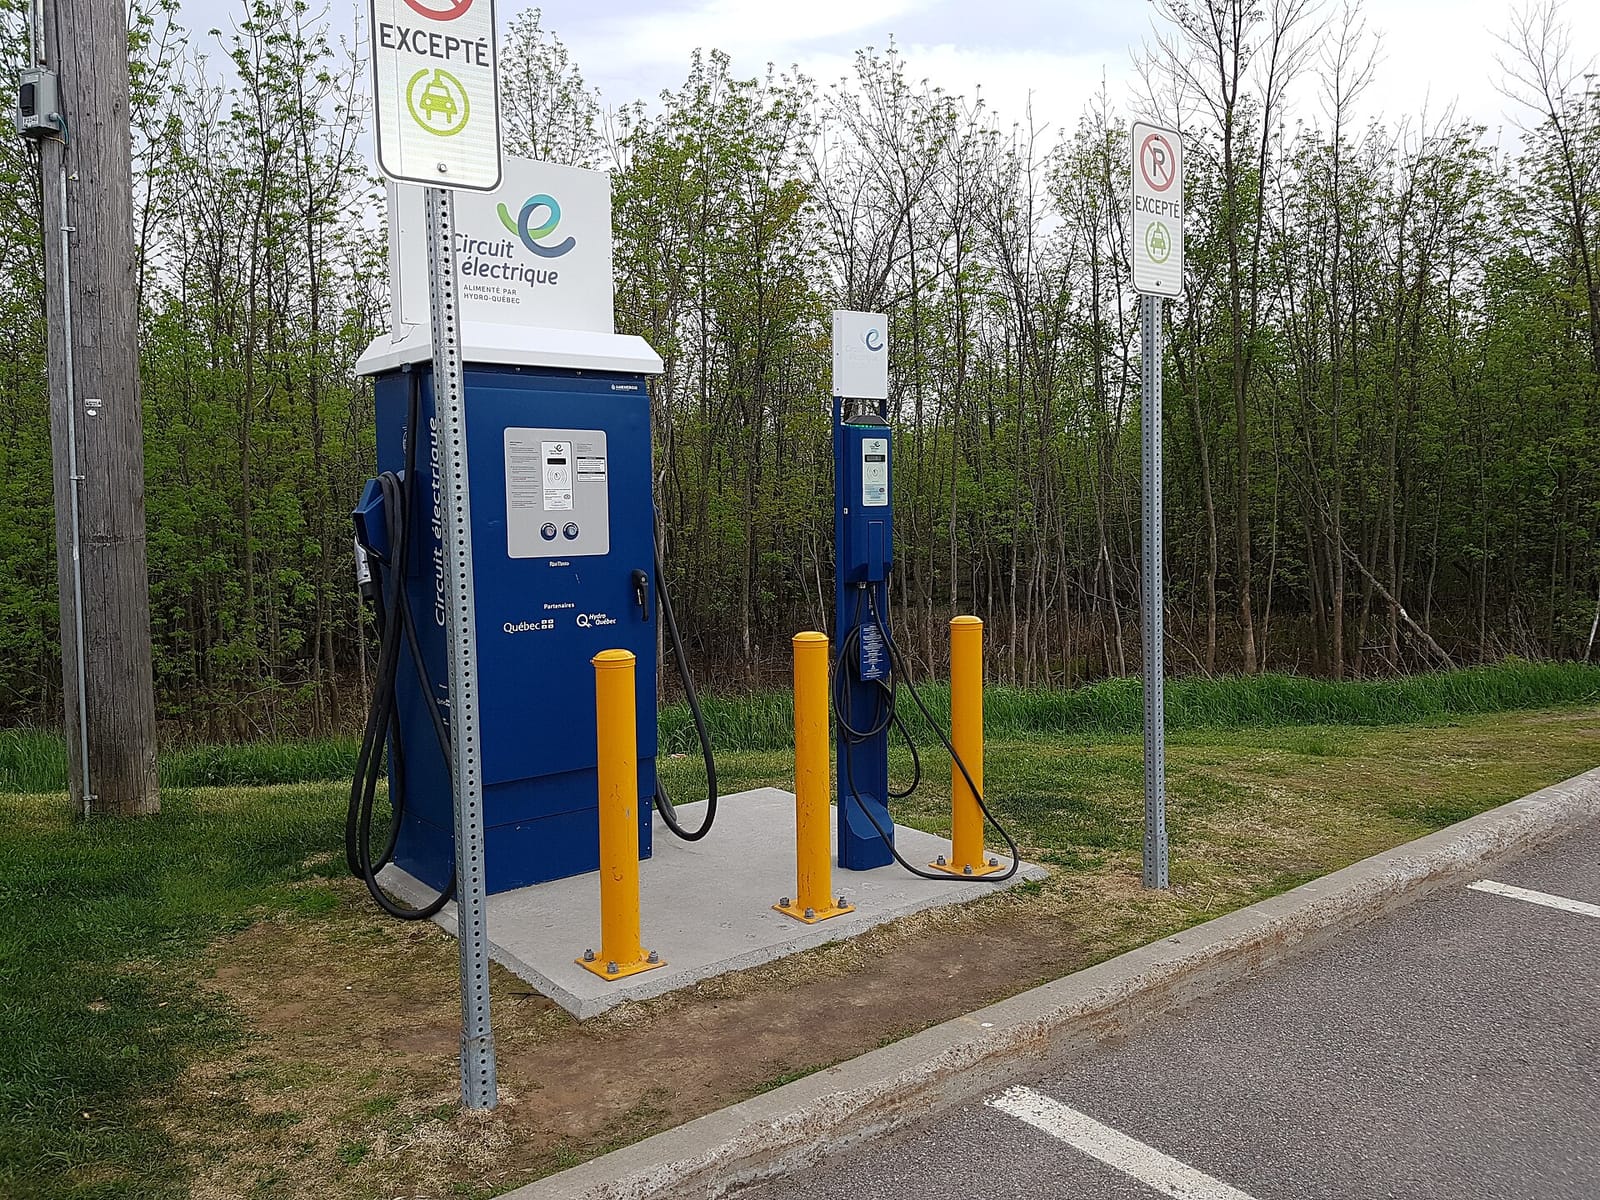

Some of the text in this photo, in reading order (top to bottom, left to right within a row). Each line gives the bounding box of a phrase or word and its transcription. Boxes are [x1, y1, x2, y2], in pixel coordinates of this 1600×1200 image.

[379, 22, 490, 68] EXCEPTÉ
[1135, 194, 1181, 219] EXCEPTÉ
[461, 255, 559, 288] électrique
[463, 284, 518, 296] ALIMENTÉ PAR
[463, 292, 521, 304] HYDRO-QUÉBEC
[433, 546, 446, 627] Circuit
[543, 602, 575, 610] Partenaires
[588, 612, 607, 621] Hydro
[595, 618, 617, 626] Québec
[503, 620, 541, 634] Québec
